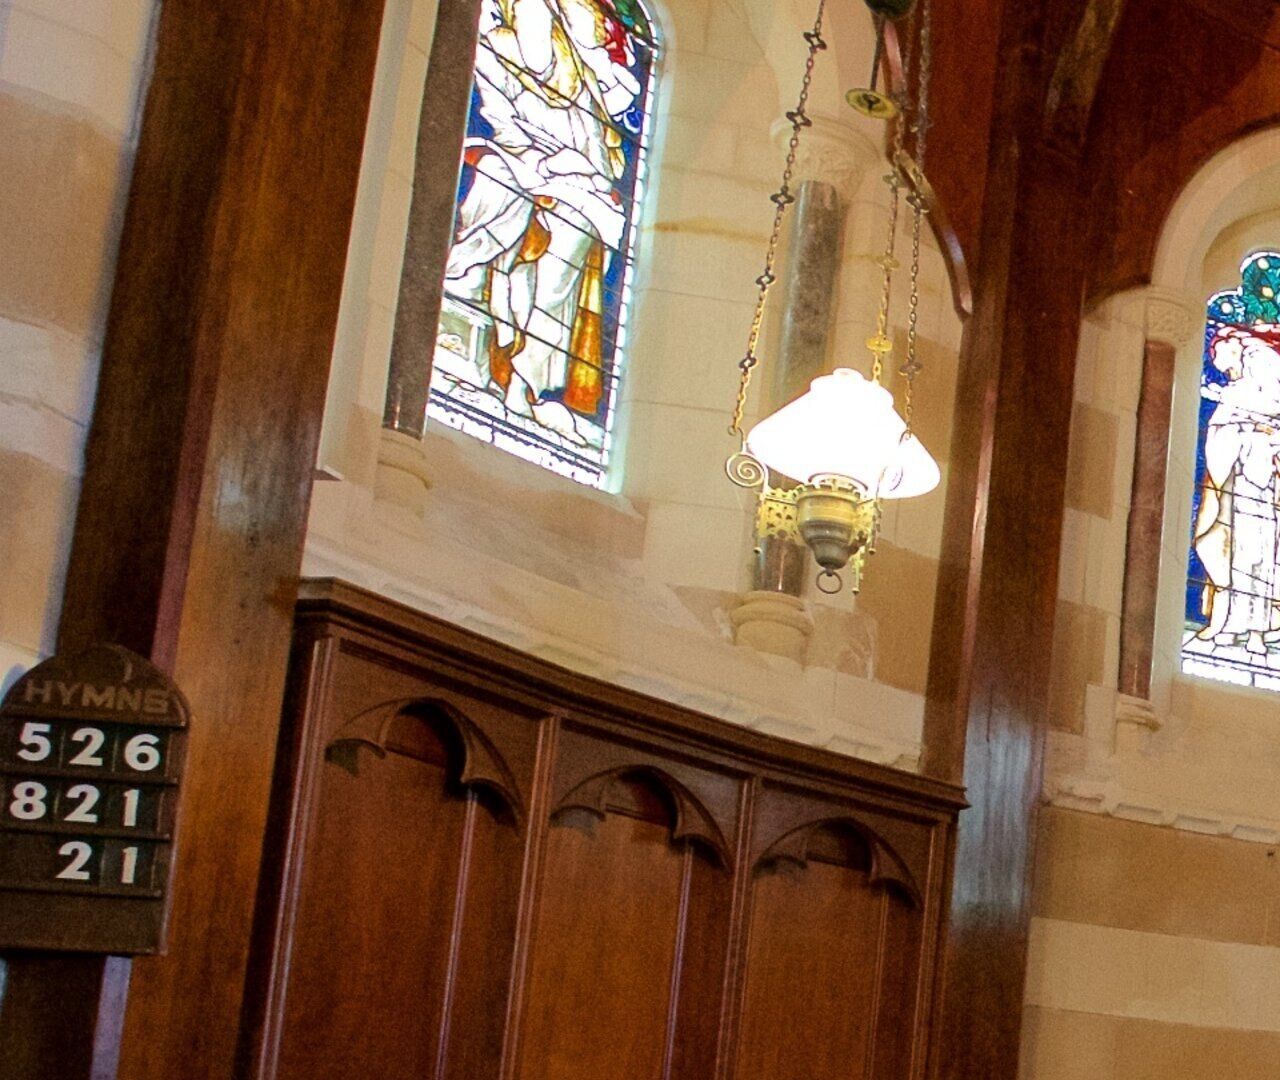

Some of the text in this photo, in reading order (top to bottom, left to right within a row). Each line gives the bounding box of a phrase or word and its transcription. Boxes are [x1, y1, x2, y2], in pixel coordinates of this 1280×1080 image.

[25, 679, 169, 714] HYMNS
[17, 722, 161, 772] 526
[10, 781, 140, 827] 821
[55, 841, 139, 884] 21
